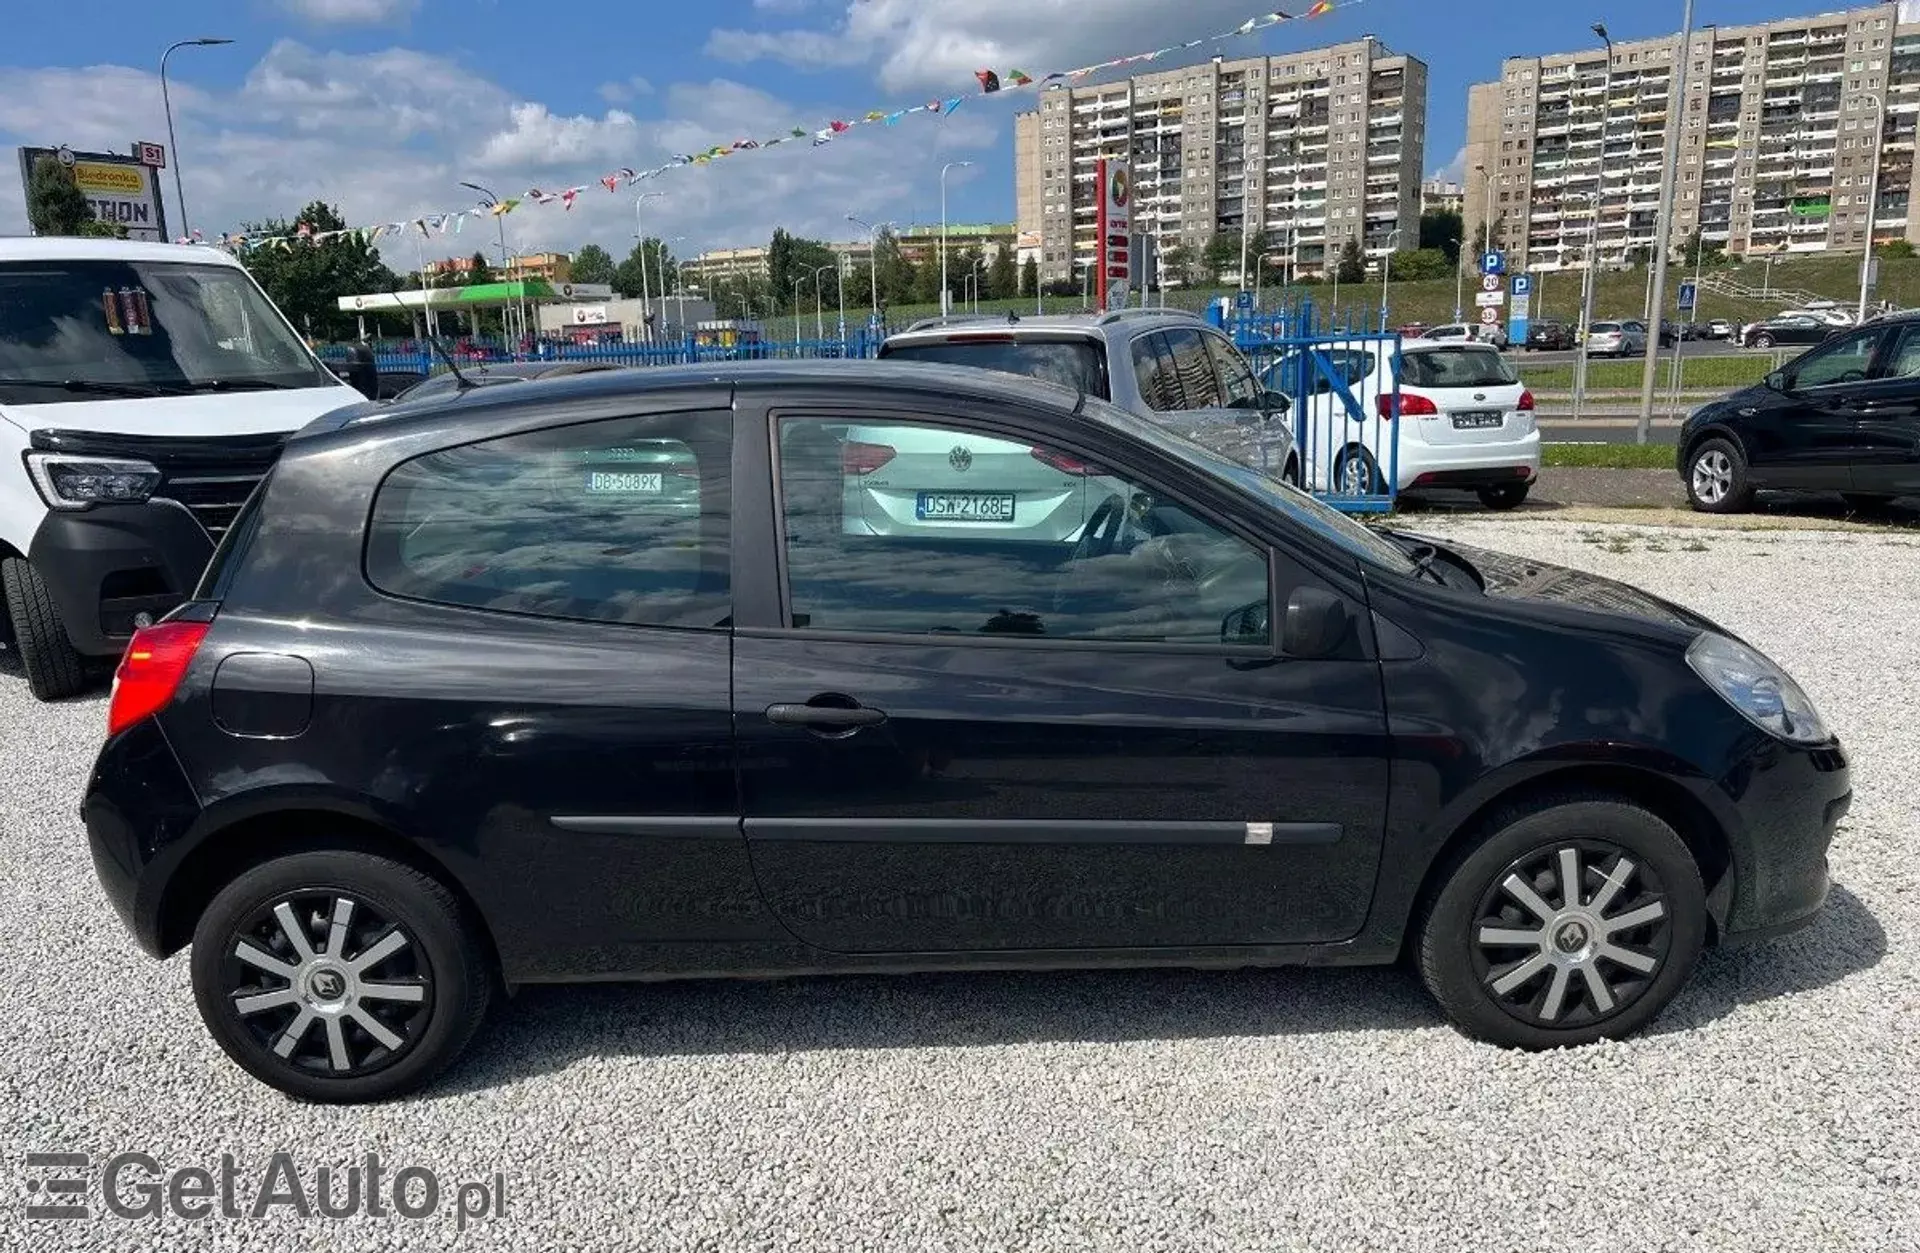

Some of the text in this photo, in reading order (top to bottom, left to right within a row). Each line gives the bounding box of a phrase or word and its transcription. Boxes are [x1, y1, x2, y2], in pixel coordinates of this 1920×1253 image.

[77, 168, 138, 183] Biedronka
[1486, 255, 1498, 271] P
[1485, 277, 1497, 288] 20
[1515, 278, 1527, 294] P
